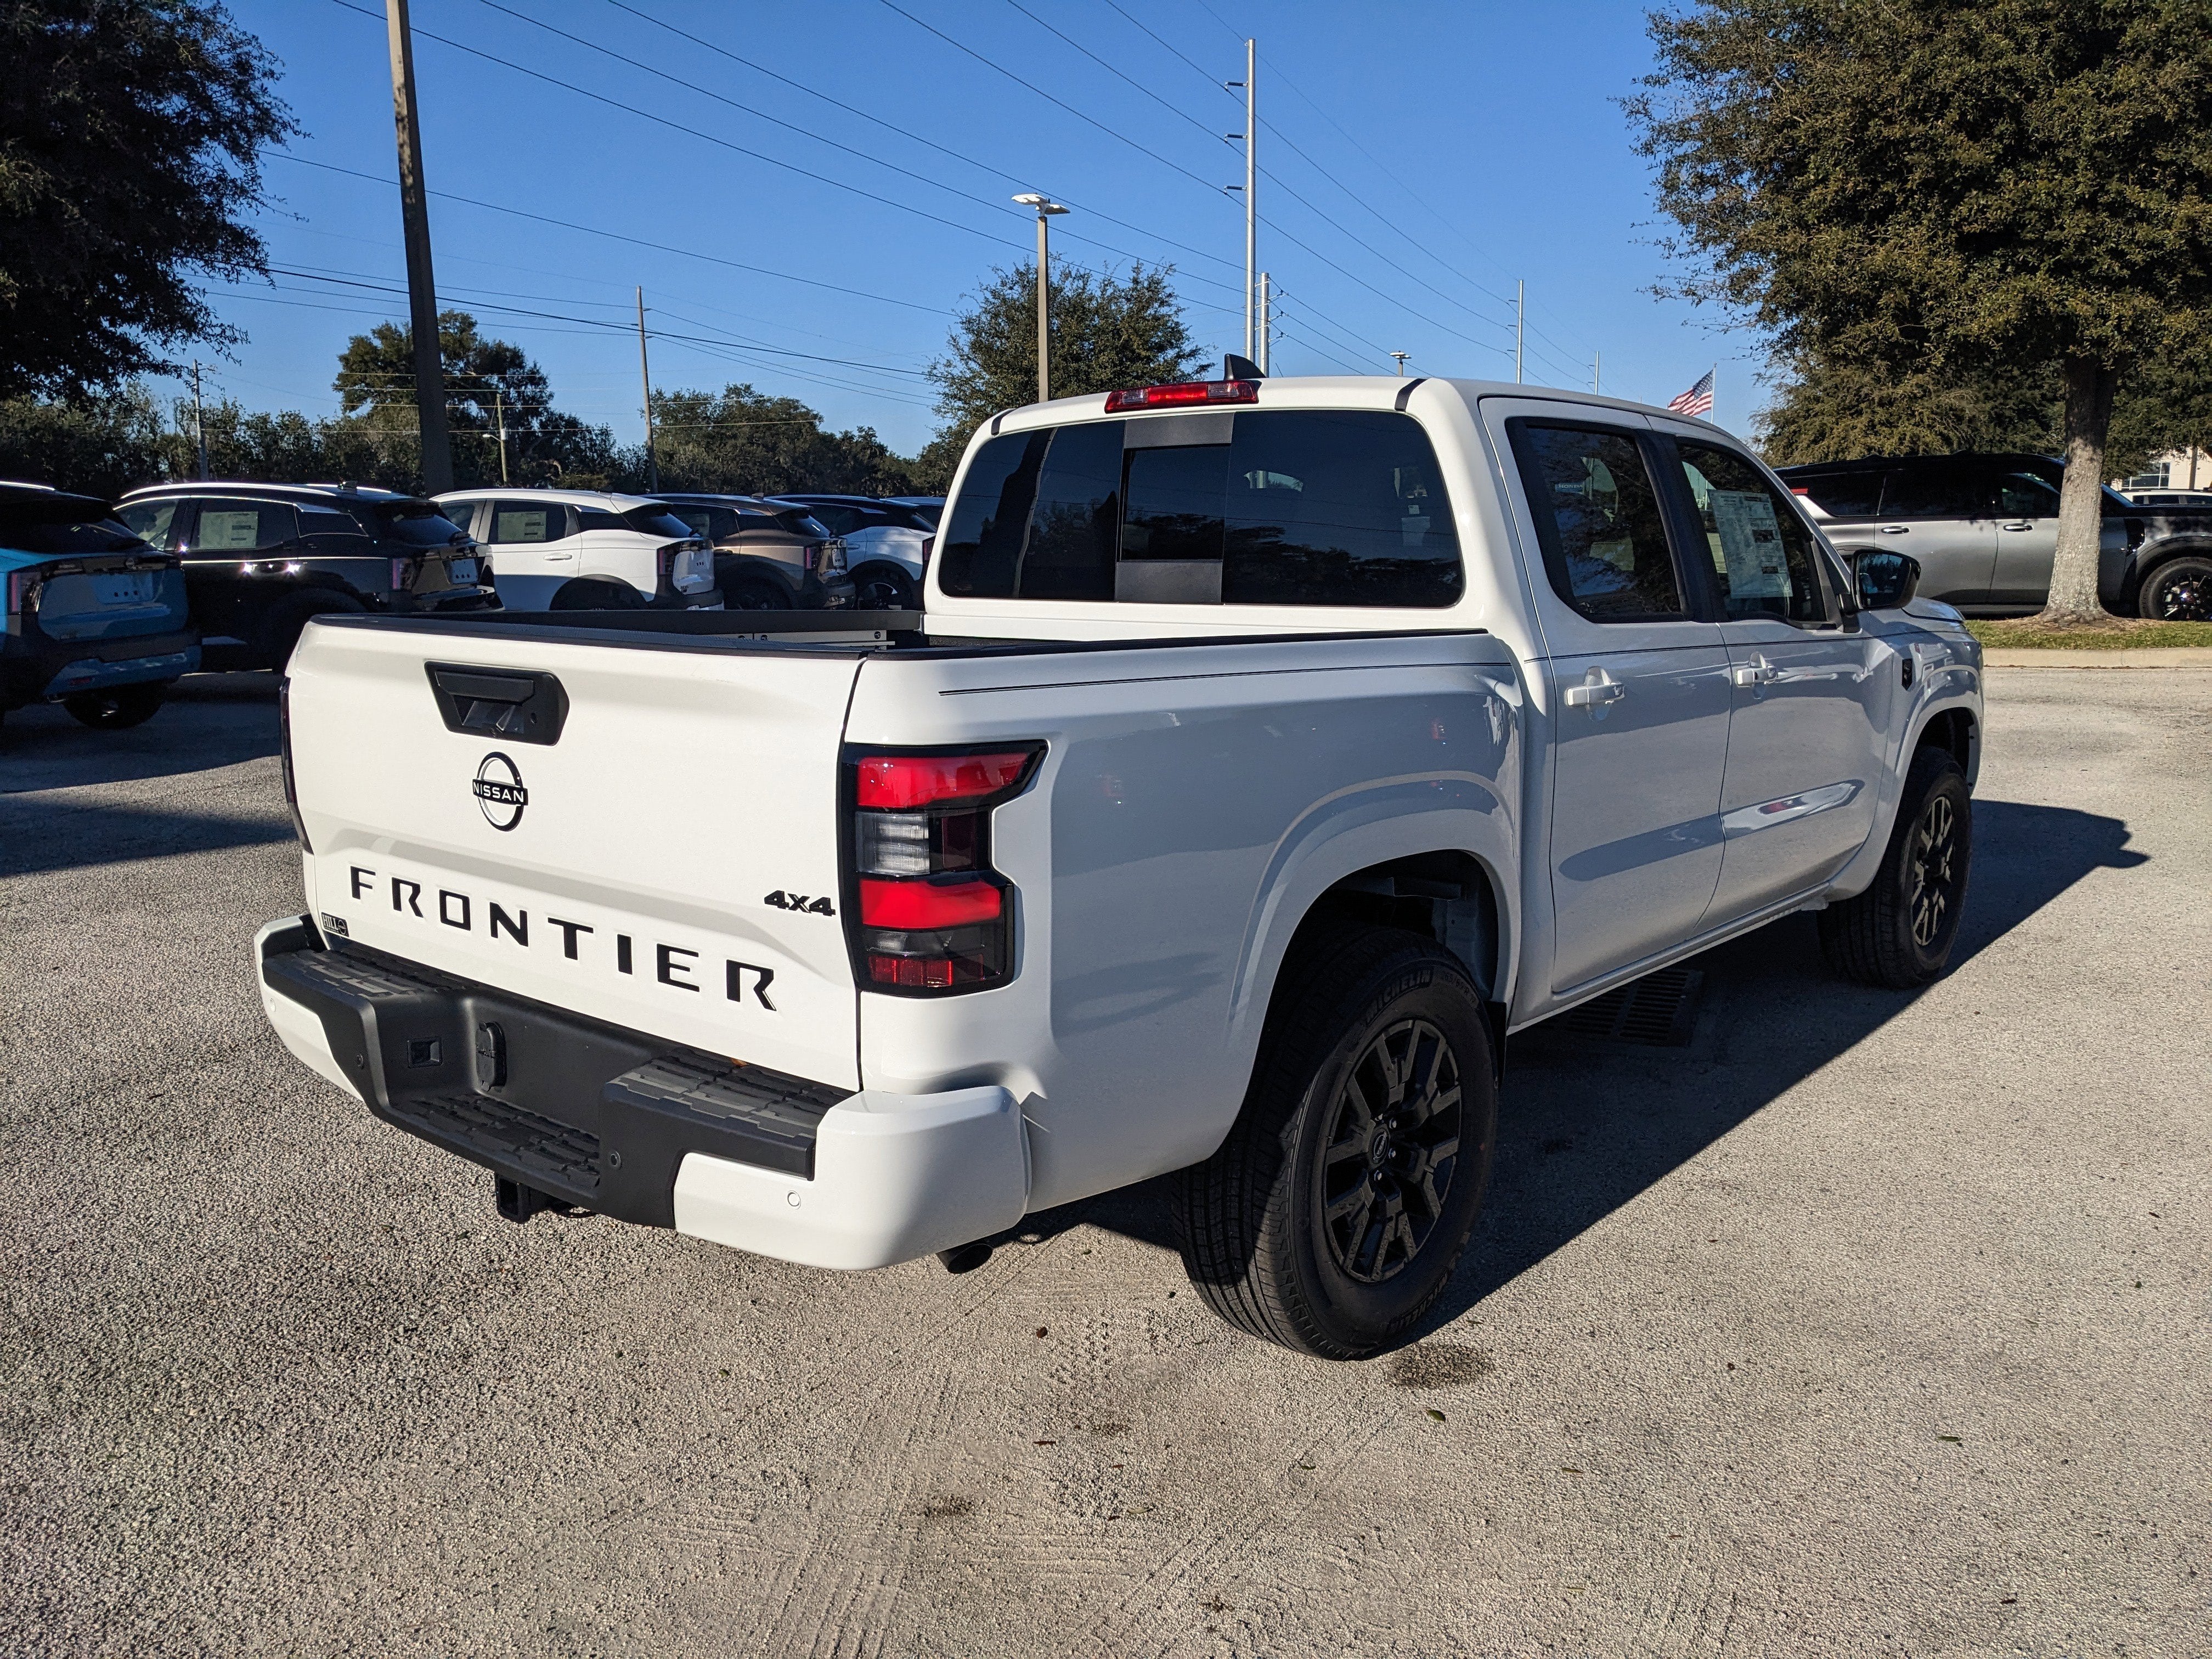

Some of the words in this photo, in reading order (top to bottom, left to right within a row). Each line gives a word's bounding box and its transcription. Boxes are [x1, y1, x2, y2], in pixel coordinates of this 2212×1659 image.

[473, 782, 523, 802] NISSAN
[322, 914, 338, 930] HILL
[350, 866, 777, 1012] FRONTIER
[1365, 969, 1431, 1024] MICHELIN
